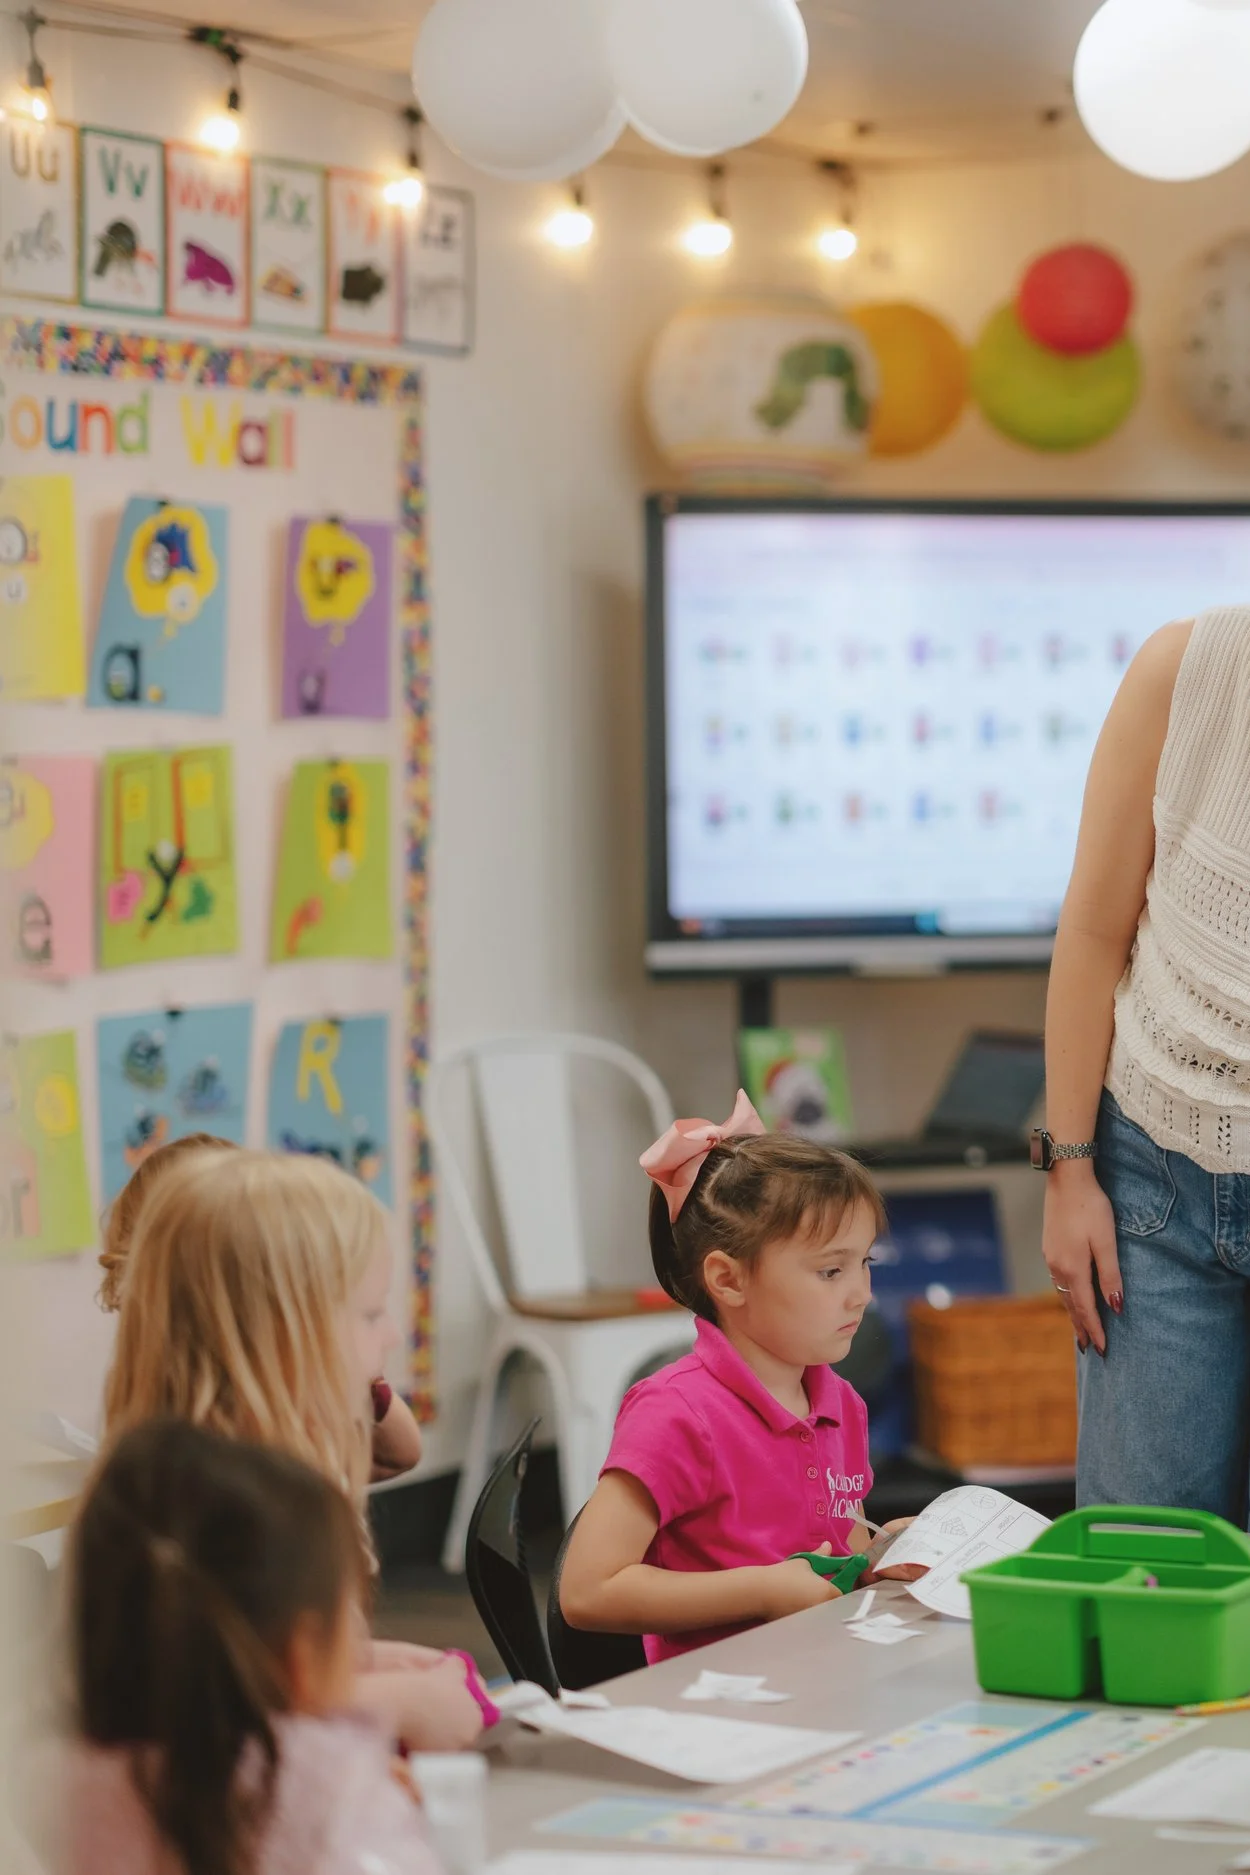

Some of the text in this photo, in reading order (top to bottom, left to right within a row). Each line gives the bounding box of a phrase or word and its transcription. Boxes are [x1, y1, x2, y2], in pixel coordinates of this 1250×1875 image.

[99, 146, 149, 198] Vv
[0, 388, 296, 472] ound Wall
[296, 1020, 342, 1115] R
